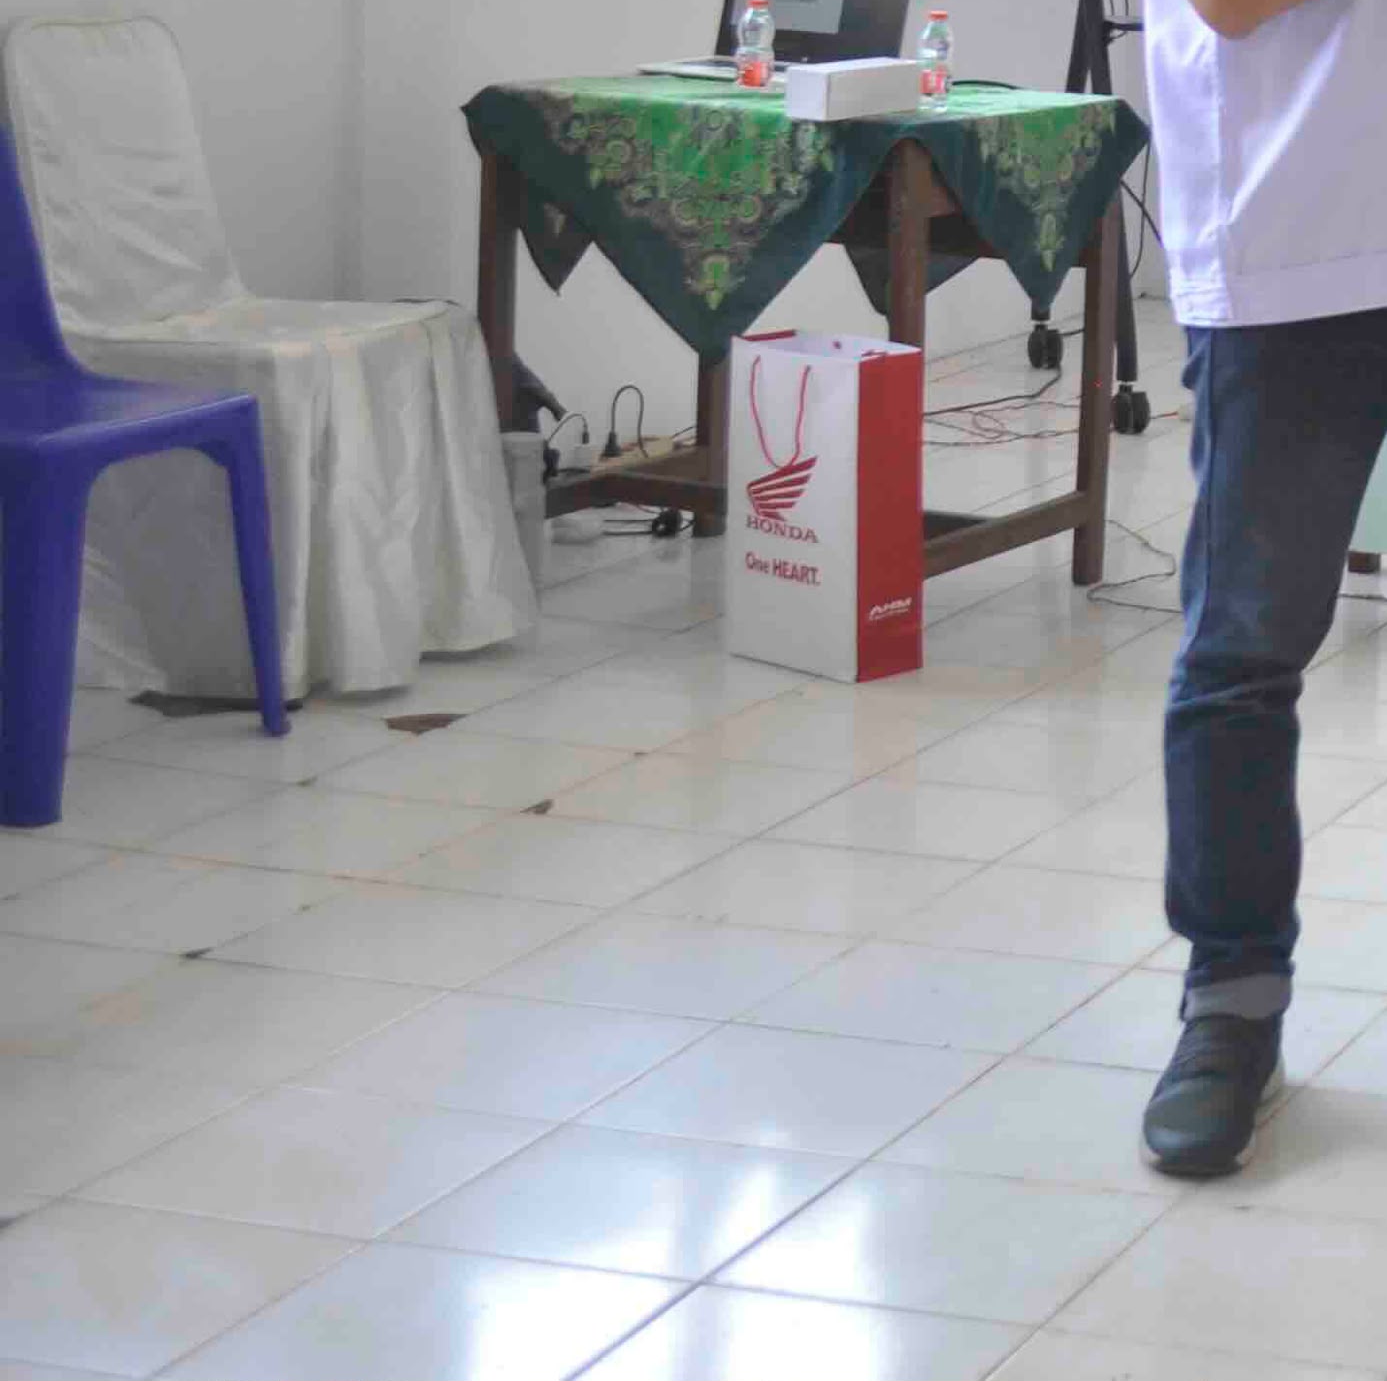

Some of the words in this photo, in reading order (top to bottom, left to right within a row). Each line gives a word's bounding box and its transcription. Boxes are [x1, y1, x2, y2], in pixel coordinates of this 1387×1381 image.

[746, 515, 820, 544] HONDA
[744, 551, 770, 575] One
[772, 557, 821, 587] HEART.
